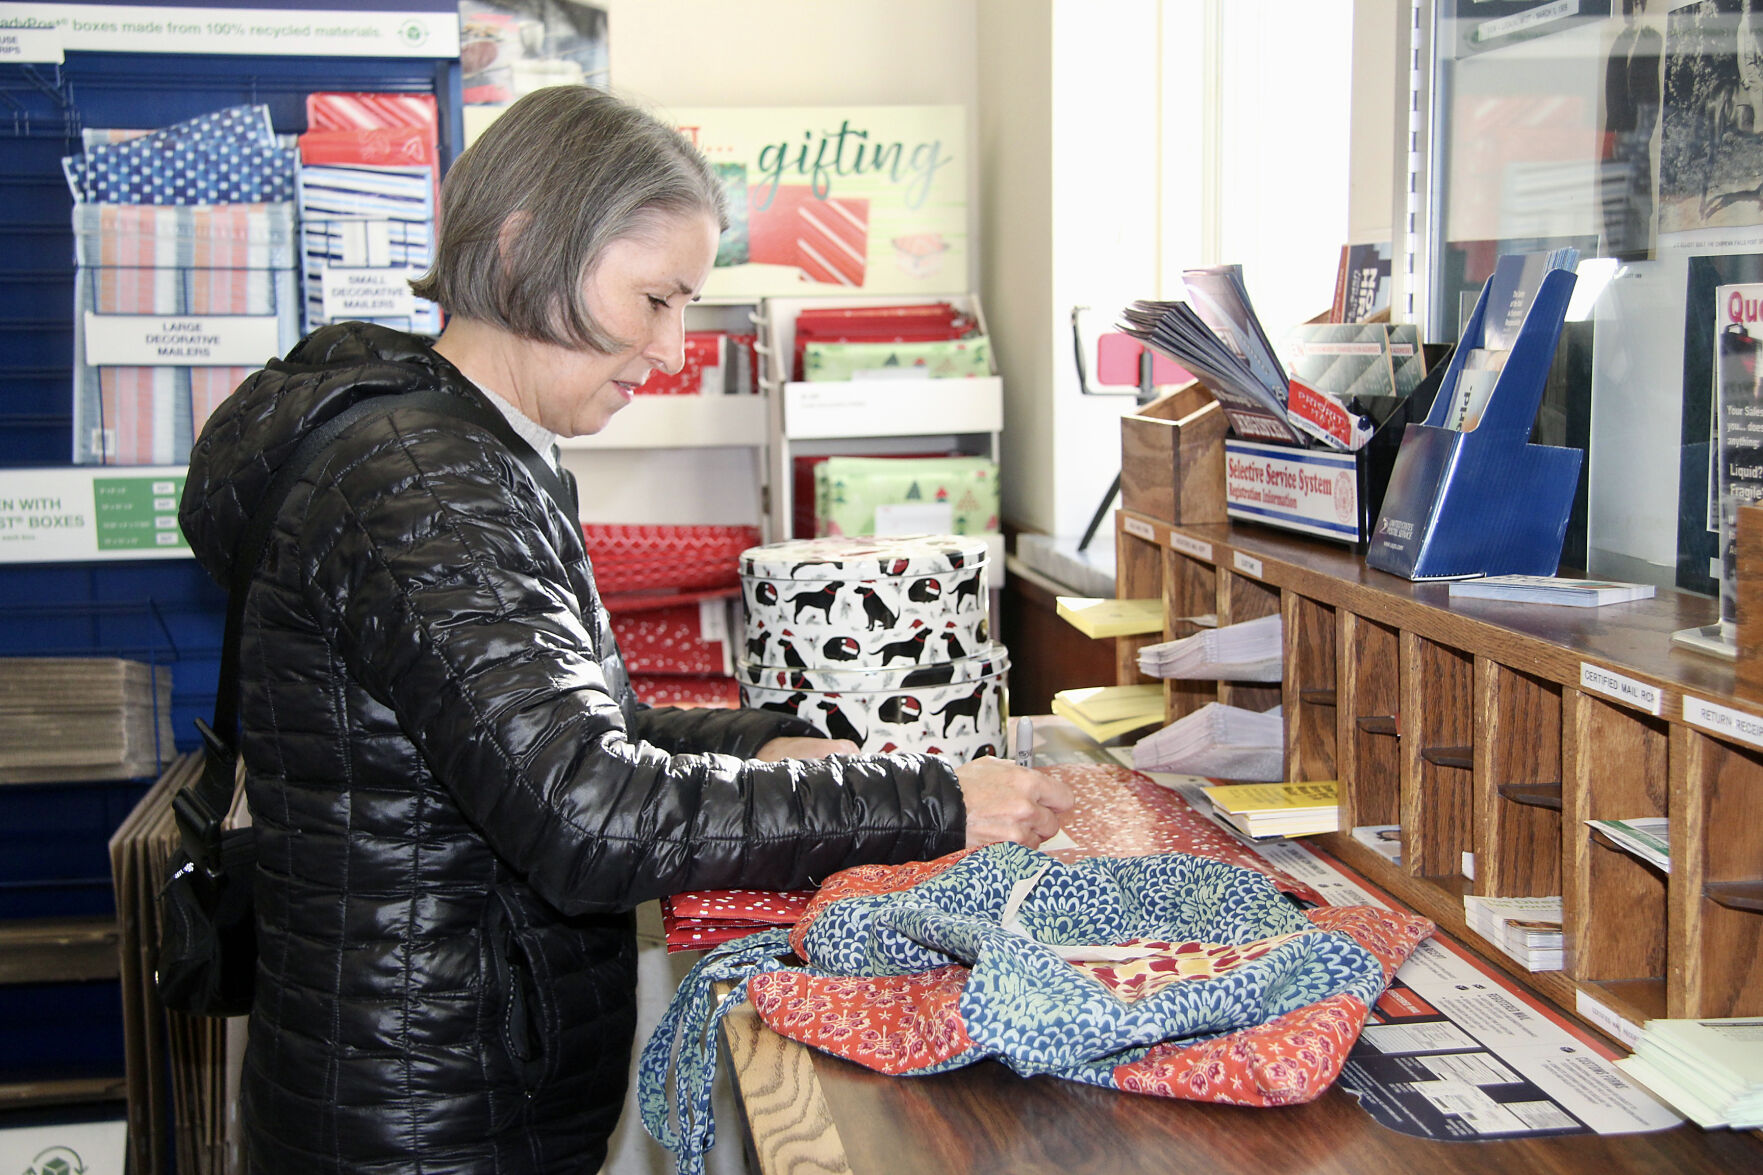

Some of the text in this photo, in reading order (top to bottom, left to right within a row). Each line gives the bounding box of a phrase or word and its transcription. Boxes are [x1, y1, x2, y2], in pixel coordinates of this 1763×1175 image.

[73, 18, 117, 32] boxes
[122, 20, 162, 33] made
[167, 21, 201, 34] from
[206, 23, 244, 35] 100%
[250, 23, 310, 38] recycled
[752, 119, 953, 212] gifting
[349, 275, 385, 284] SMALL
[331, 287, 404, 297] DECORATIVE
[344, 300, 395, 308] MAILERS
[163, 322, 203, 331] LARGE
[146, 334, 220, 344] DECORATIVE
[158, 347, 211, 357] MAILERS
[1727, 404, 1743, 416] Your
[1228, 457, 1332, 497] Selective Service System
[1730, 463, 1763, 480] Liquid?
[1228, 482, 1298, 509] Registration Information
[0, 498, 61, 511] N WITH
[28, 514, 85, 529] BOXES
[1584, 670, 1618, 690] CERTIFIED
[1621, 683, 1638, 698] MAIL
[1701, 708, 1733, 726] RETURN
